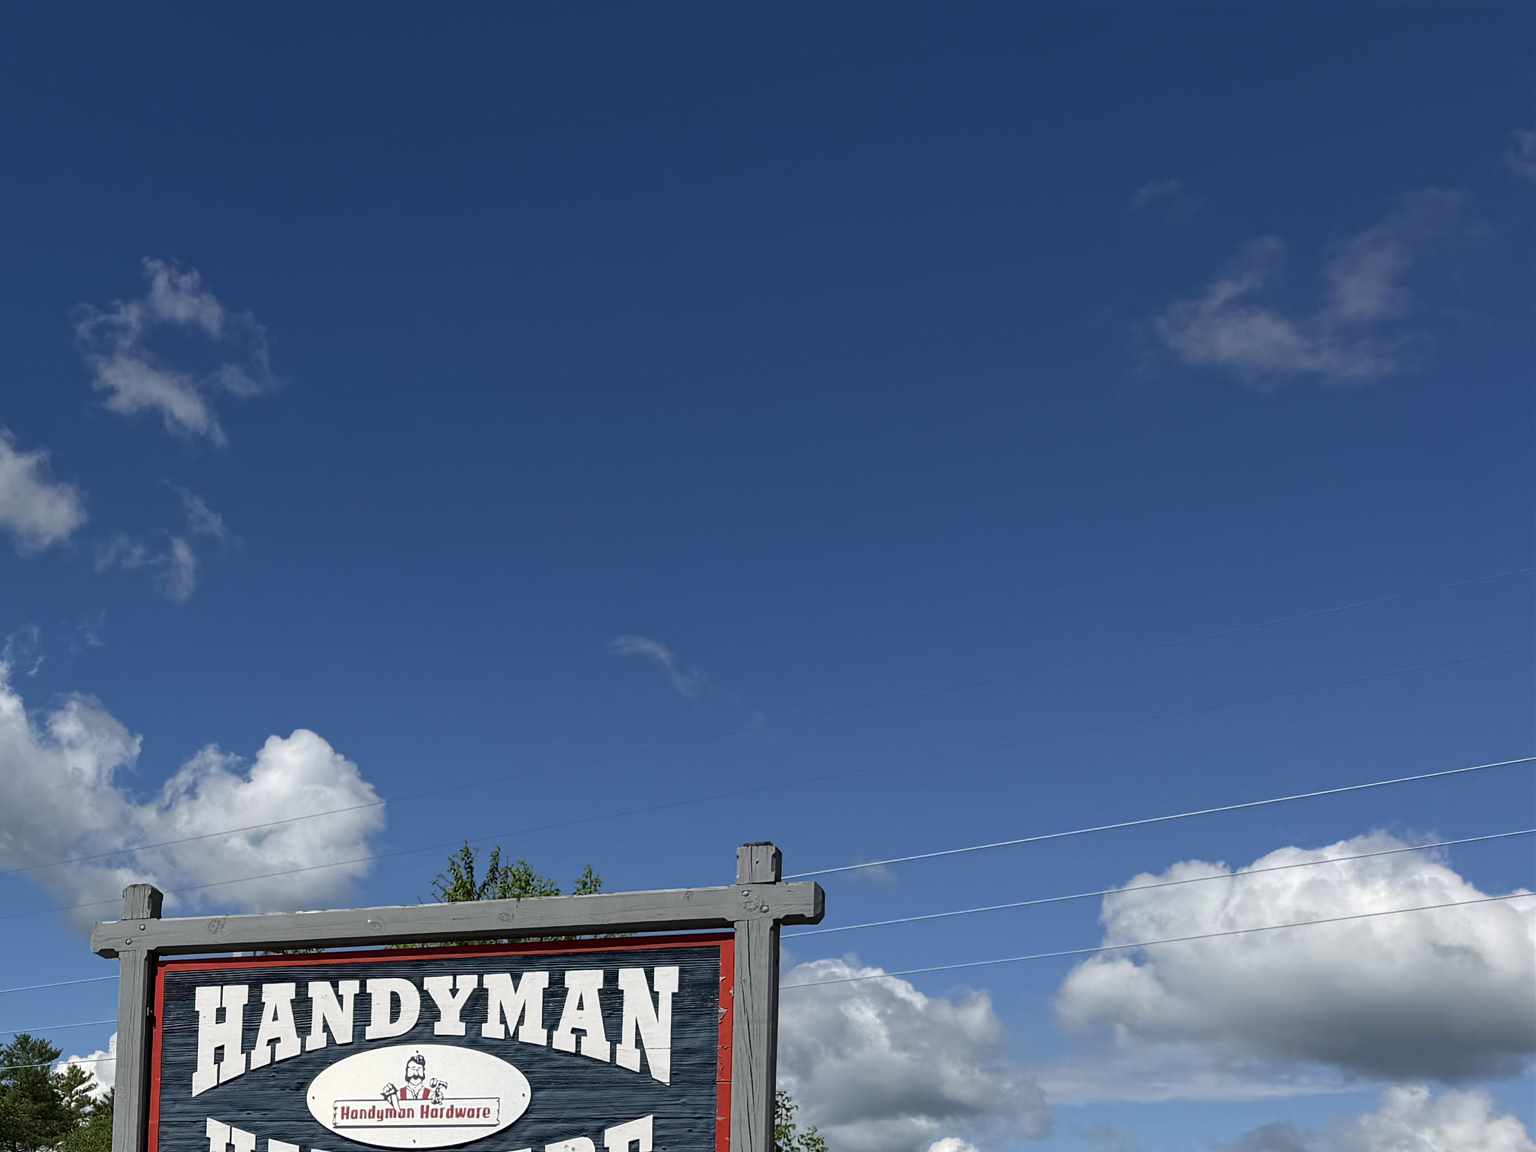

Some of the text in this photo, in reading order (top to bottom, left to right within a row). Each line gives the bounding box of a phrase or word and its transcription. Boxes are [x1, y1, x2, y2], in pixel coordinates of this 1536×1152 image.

[192, 966, 679, 1097] HANDYMAN
[340, 1104, 491, 1122] Handyman Hardware
